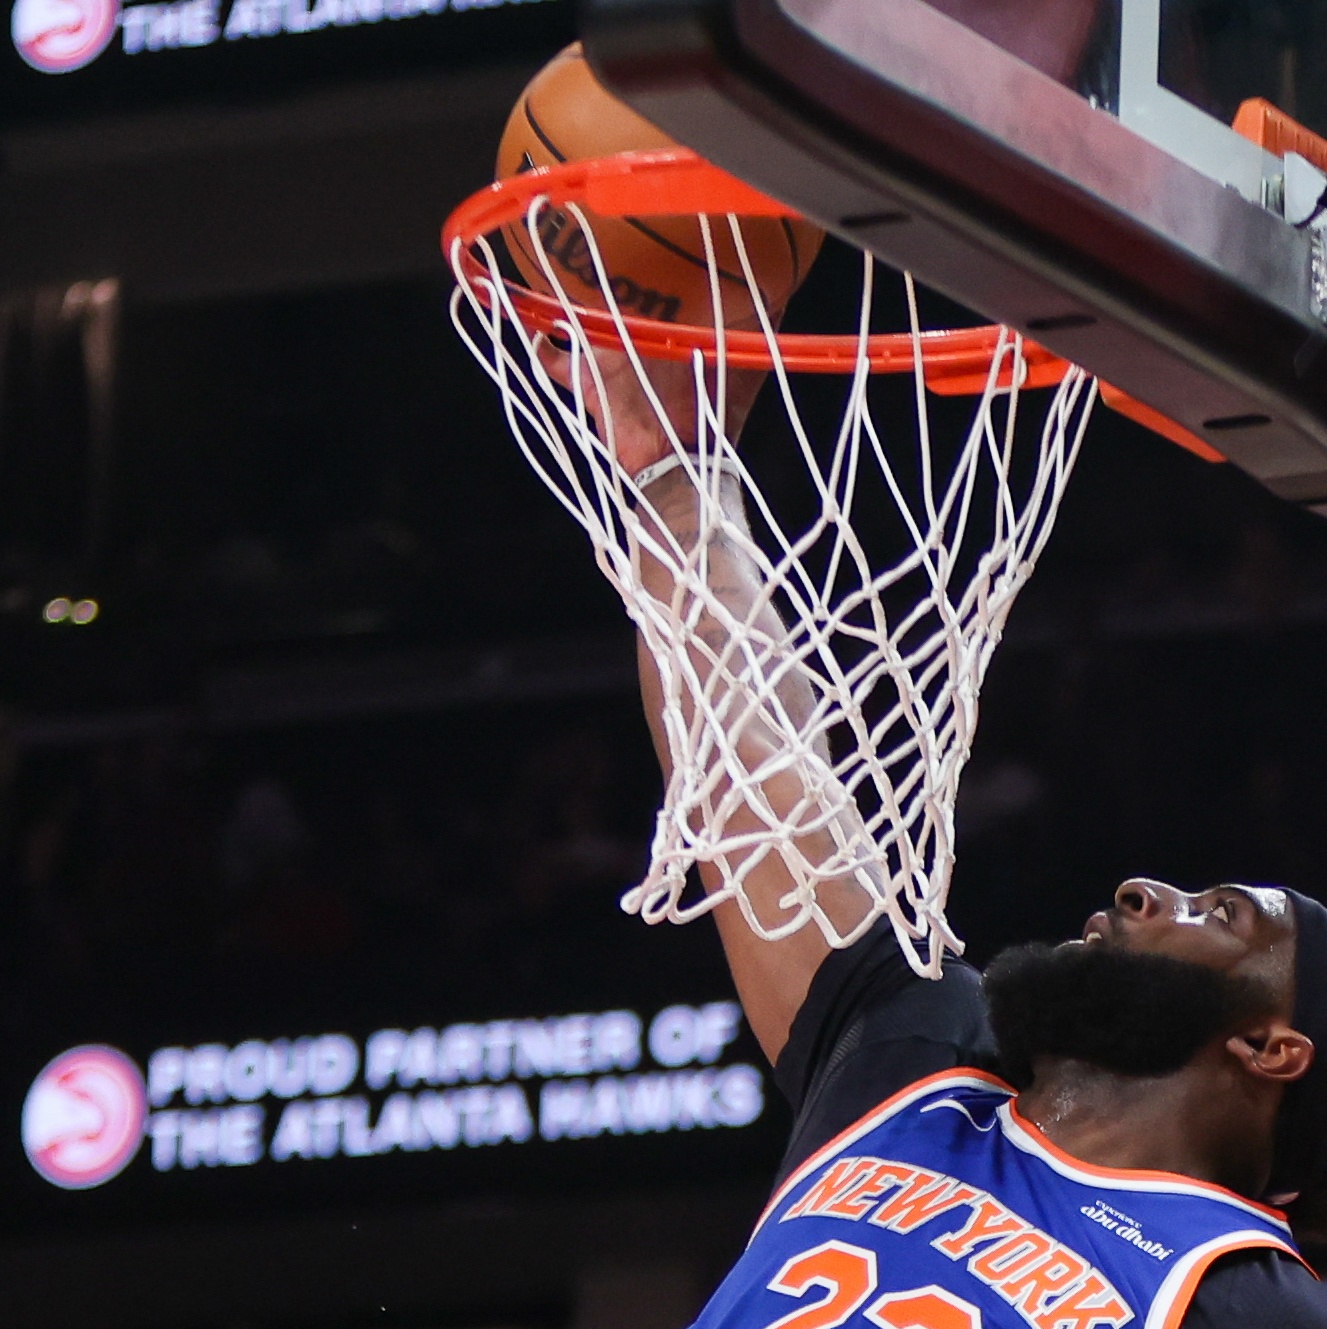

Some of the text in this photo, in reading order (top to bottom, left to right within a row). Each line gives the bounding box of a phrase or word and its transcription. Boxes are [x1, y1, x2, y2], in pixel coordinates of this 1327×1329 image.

[116, 0, 221, 54] THE
[148, 1000, 743, 1107] PROUD PARTNER OF
[145, 1063, 765, 1173] THE ATLANTA HAWKS
[779, 1156, 974, 1235] NEW
[1080, 1206, 1174, 1261] abu dhabi
